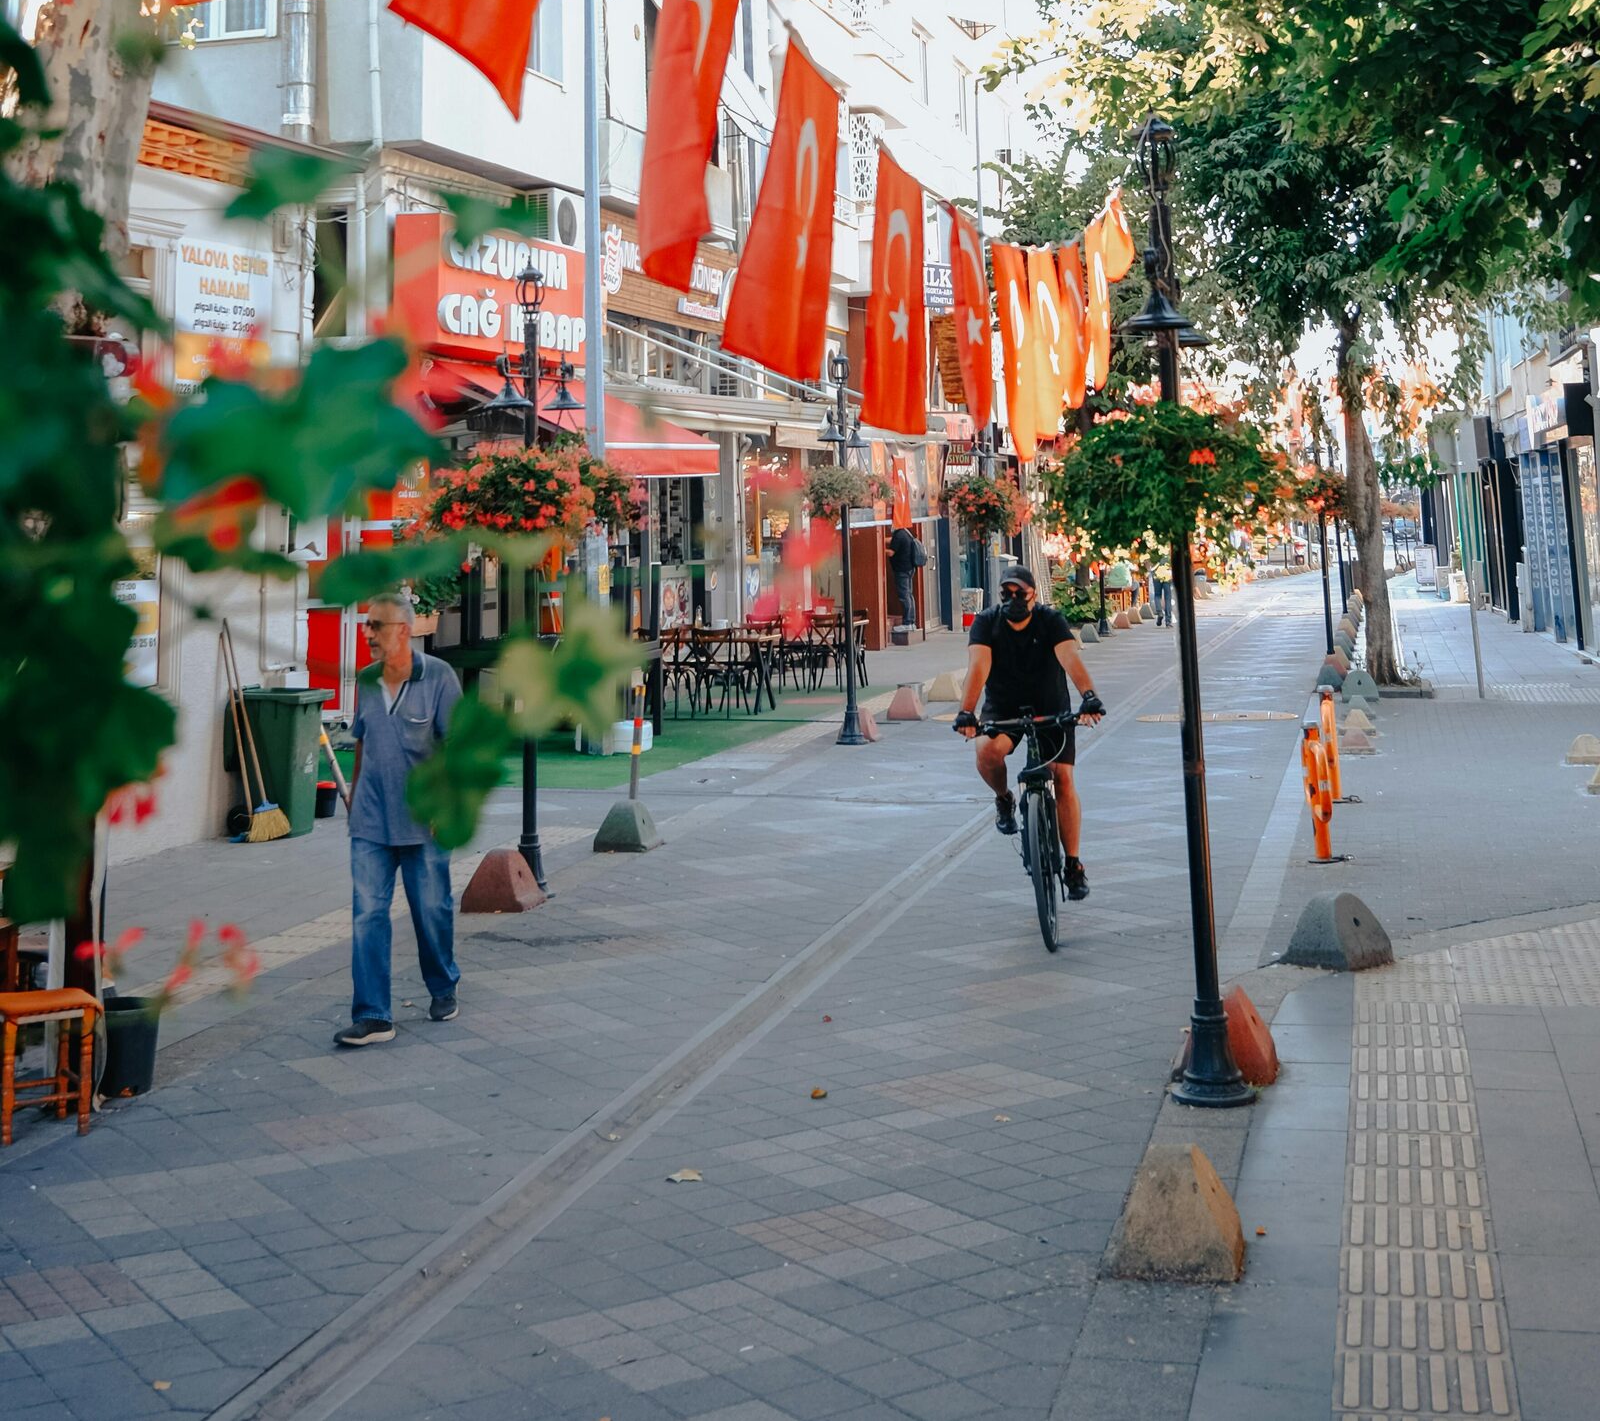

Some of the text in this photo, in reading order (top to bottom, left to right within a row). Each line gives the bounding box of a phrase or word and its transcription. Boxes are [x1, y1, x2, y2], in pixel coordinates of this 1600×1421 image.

[181, 245, 229, 269] YALOVA
[438, 289, 587, 353] CAĞ KBAP
